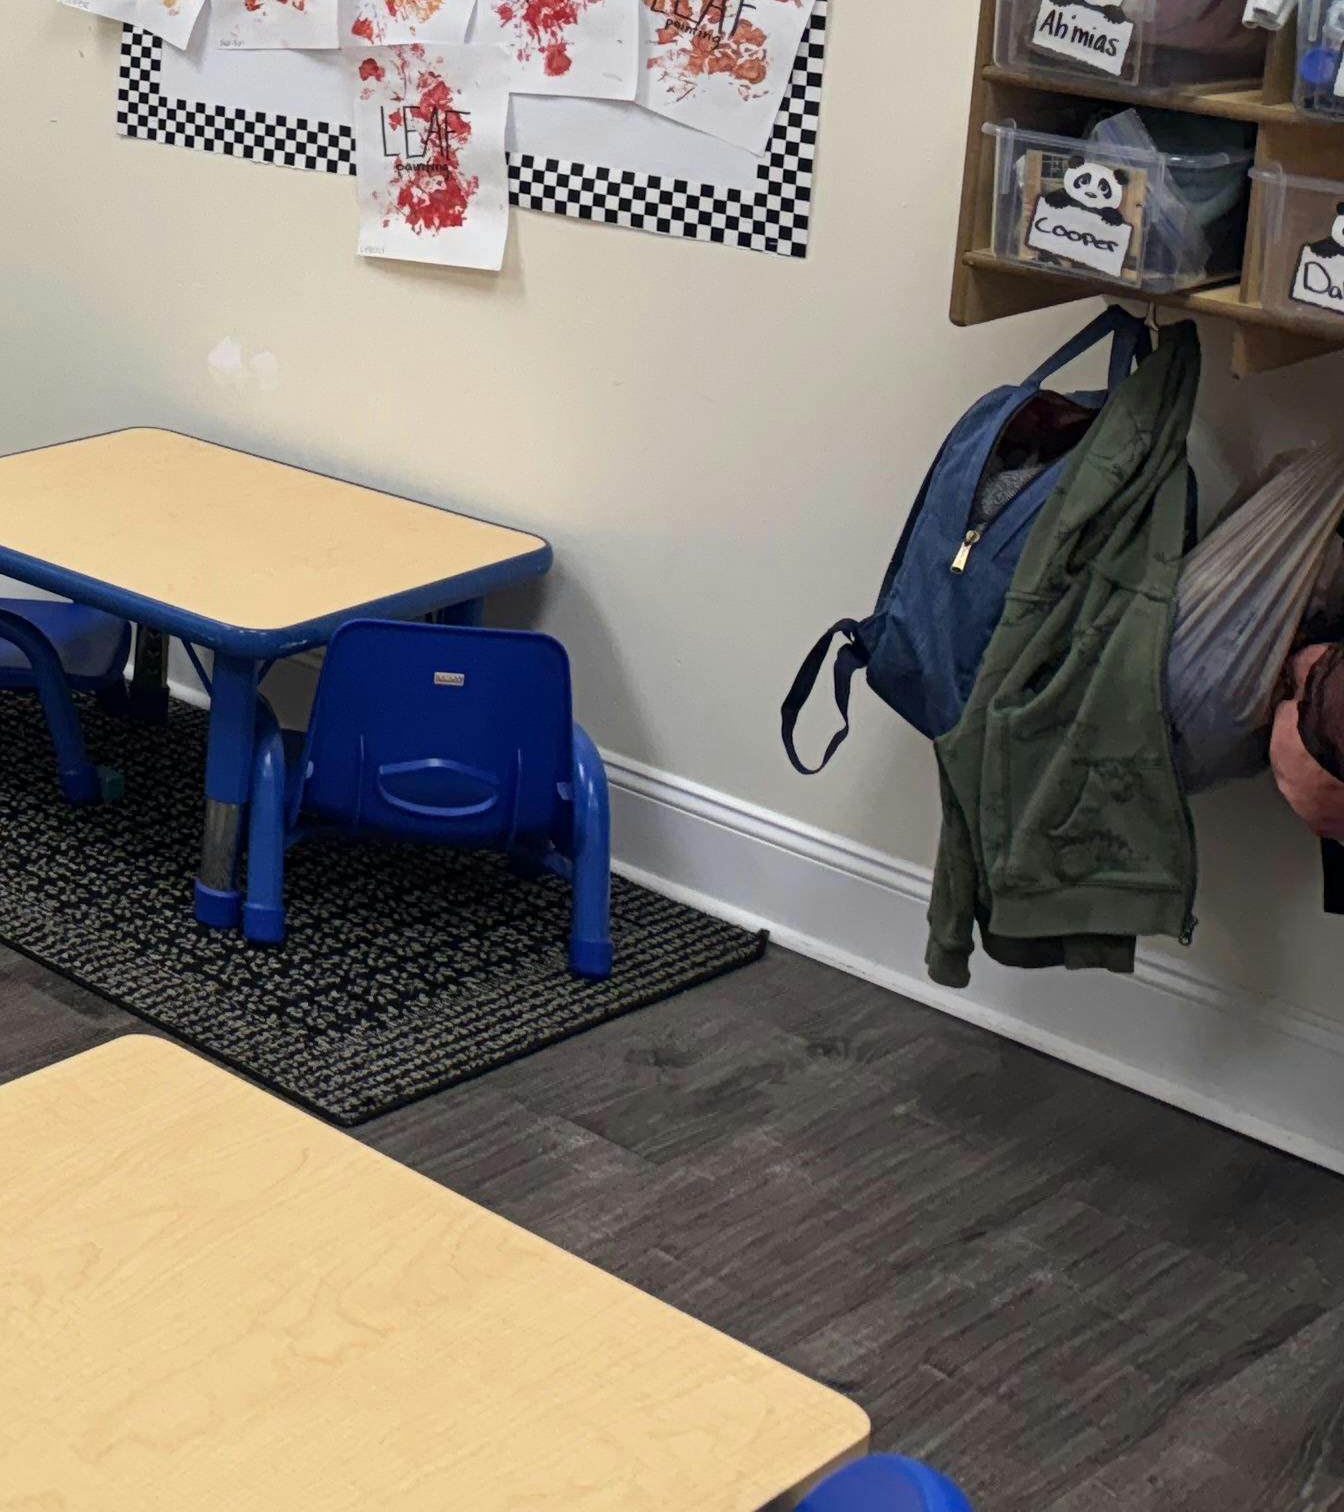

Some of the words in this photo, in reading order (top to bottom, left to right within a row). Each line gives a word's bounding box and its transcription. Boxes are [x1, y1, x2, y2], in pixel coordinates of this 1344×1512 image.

[664, 18, 722, 50] painting
[381, 106, 471, 161] LEAF
[1035, 217, 1119, 253] Cooper
